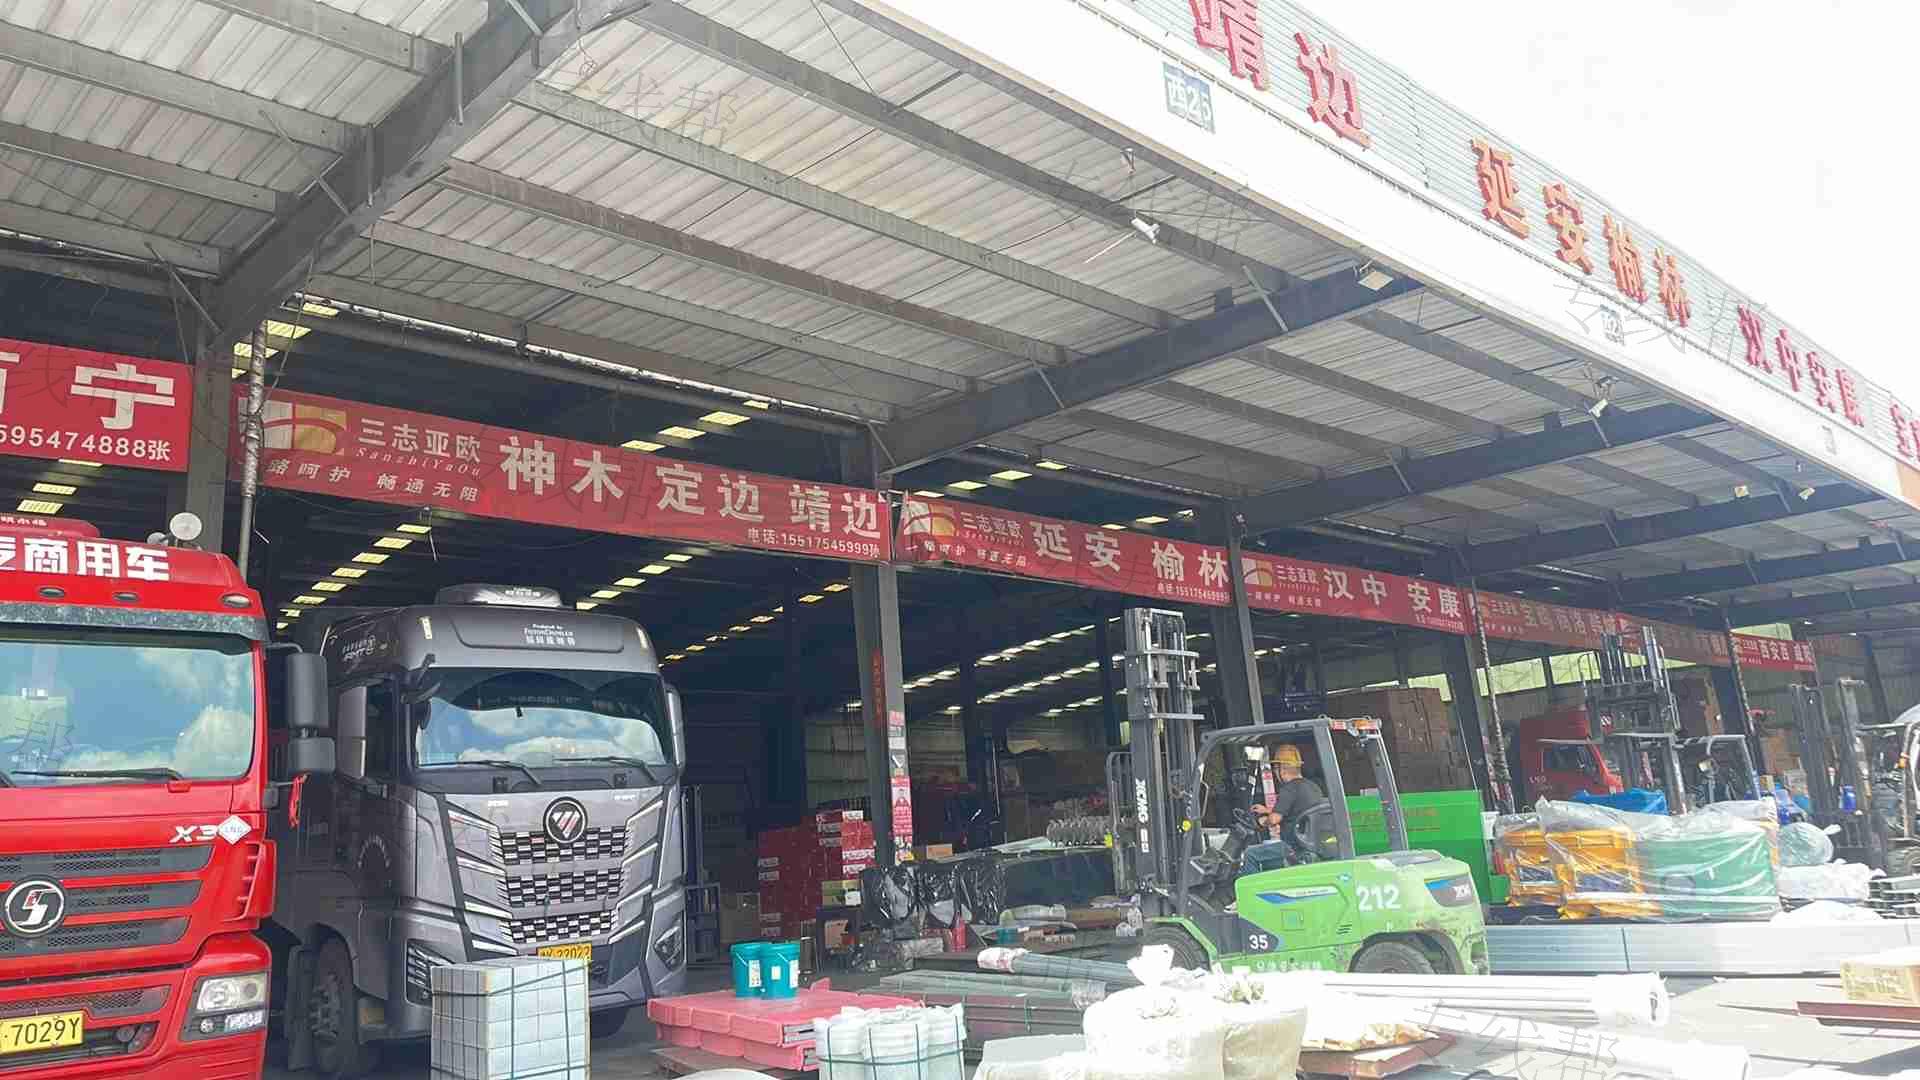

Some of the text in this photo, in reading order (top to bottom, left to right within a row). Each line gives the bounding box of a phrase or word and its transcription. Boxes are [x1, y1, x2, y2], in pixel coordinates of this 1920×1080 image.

[1470, 136, 1691, 328] 延安榆林
[357, 416, 481, 464] 三志亚欧
[376, 473, 480, 503] 畅通无阻
[499, 434, 881, 540] 神木 定边 靖边
[1030, 520, 1231, 589] 延安 榆林
[1323, 566, 1388, 608] 汉中
[1406, 581, 1463, 619] 安康
[1357, 884, 1401, 912] 212
[1248, 934, 1269, 950] 35
